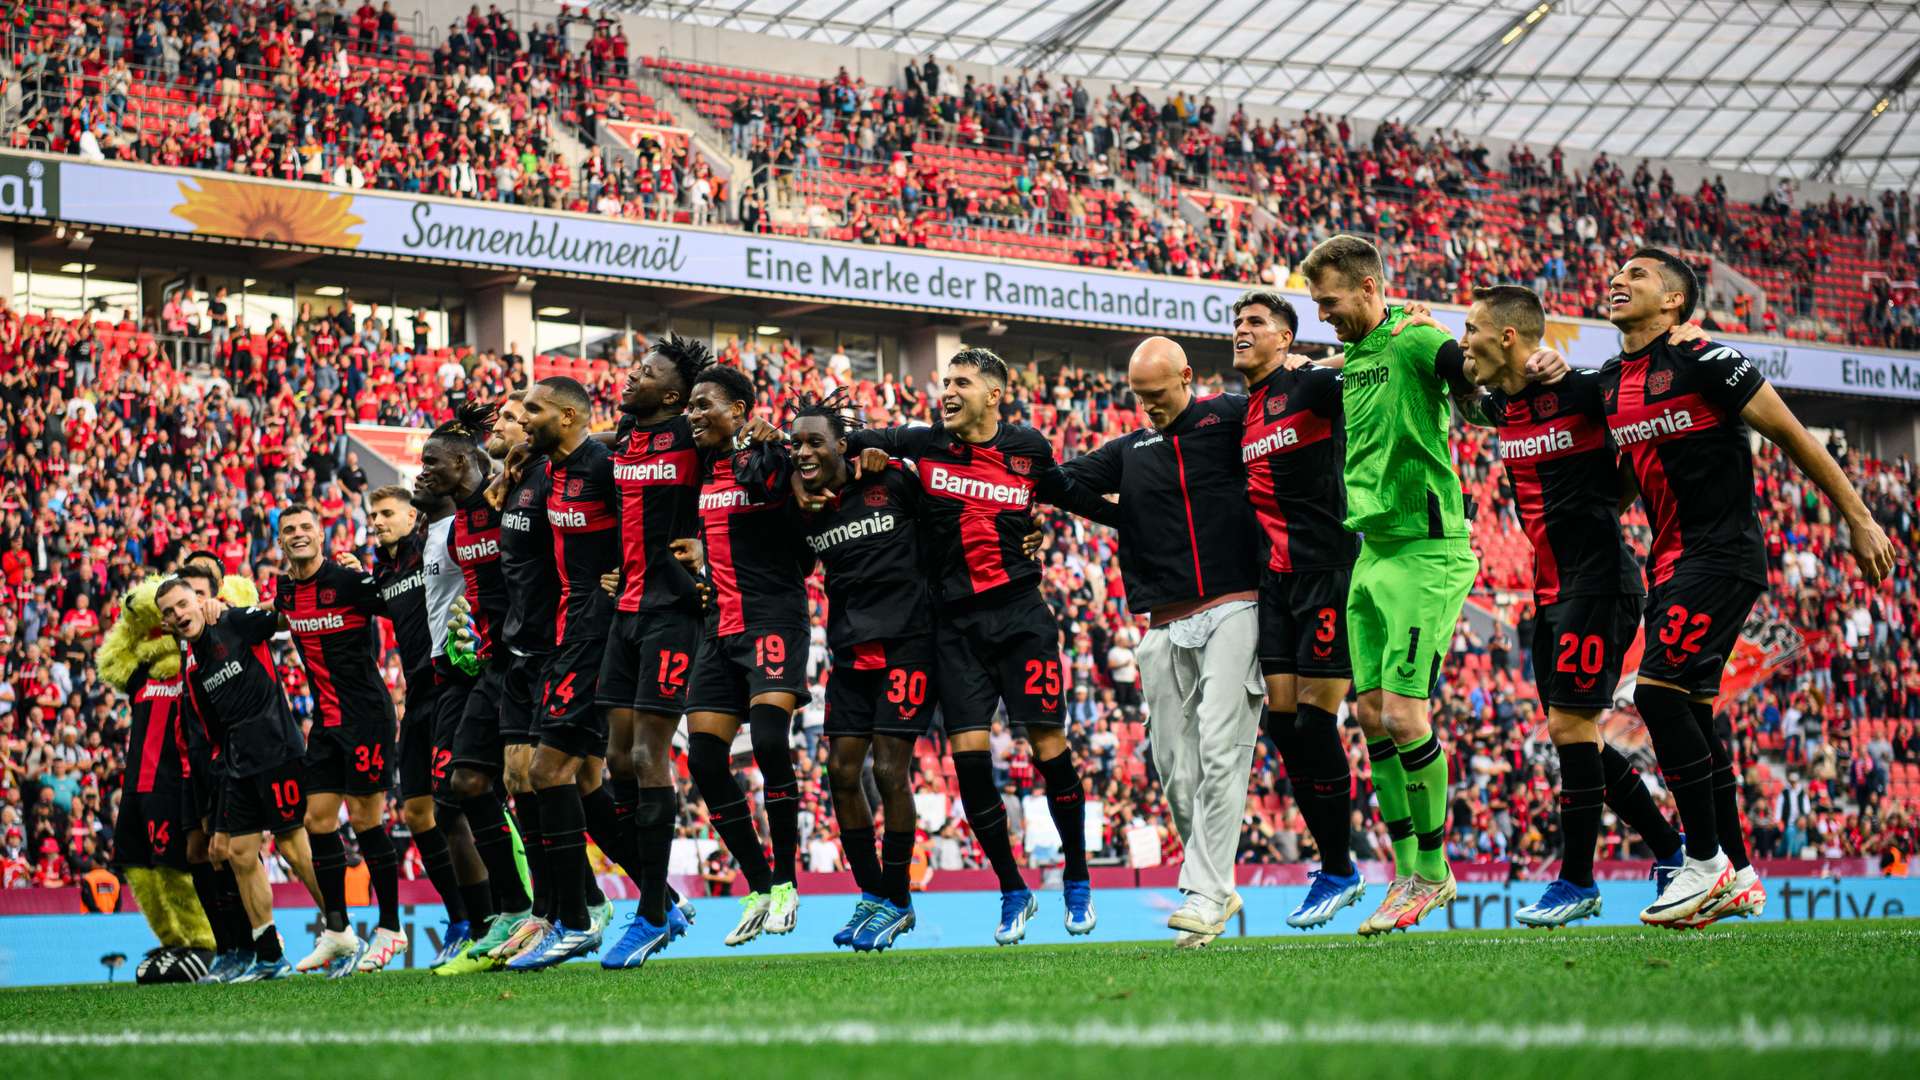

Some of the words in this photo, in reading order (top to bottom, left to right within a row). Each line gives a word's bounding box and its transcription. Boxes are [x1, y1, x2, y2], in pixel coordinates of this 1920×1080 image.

[403, 202, 687, 272] Sonnenblumenöl
[746, 248, 812, 284] Eine
[821, 255, 919, 294] Marke
[928, 266, 977, 299] der
[984, 272, 1196, 320] Ramachandran
[1841, 359, 1885, 387] Eine
[1499, 427, 1574, 459] armenia
[1612, 408, 1693, 447] armenia
[613, 457, 677, 480] armenia
[931, 467, 1030, 505] Barmenia
[1315, 607, 1337, 642] 3
[1660, 604, 1712, 654] 32
[755, 634, 786, 667] 19
[1406, 626, 1421, 664] 1
[1557, 632, 1605, 674] 20
[656, 649, 689, 686] 12
[1024, 659, 1060, 696] 25
[887, 669, 928, 705] 30
[355, 743, 385, 773] 34
[271, 779, 300, 809] 10
